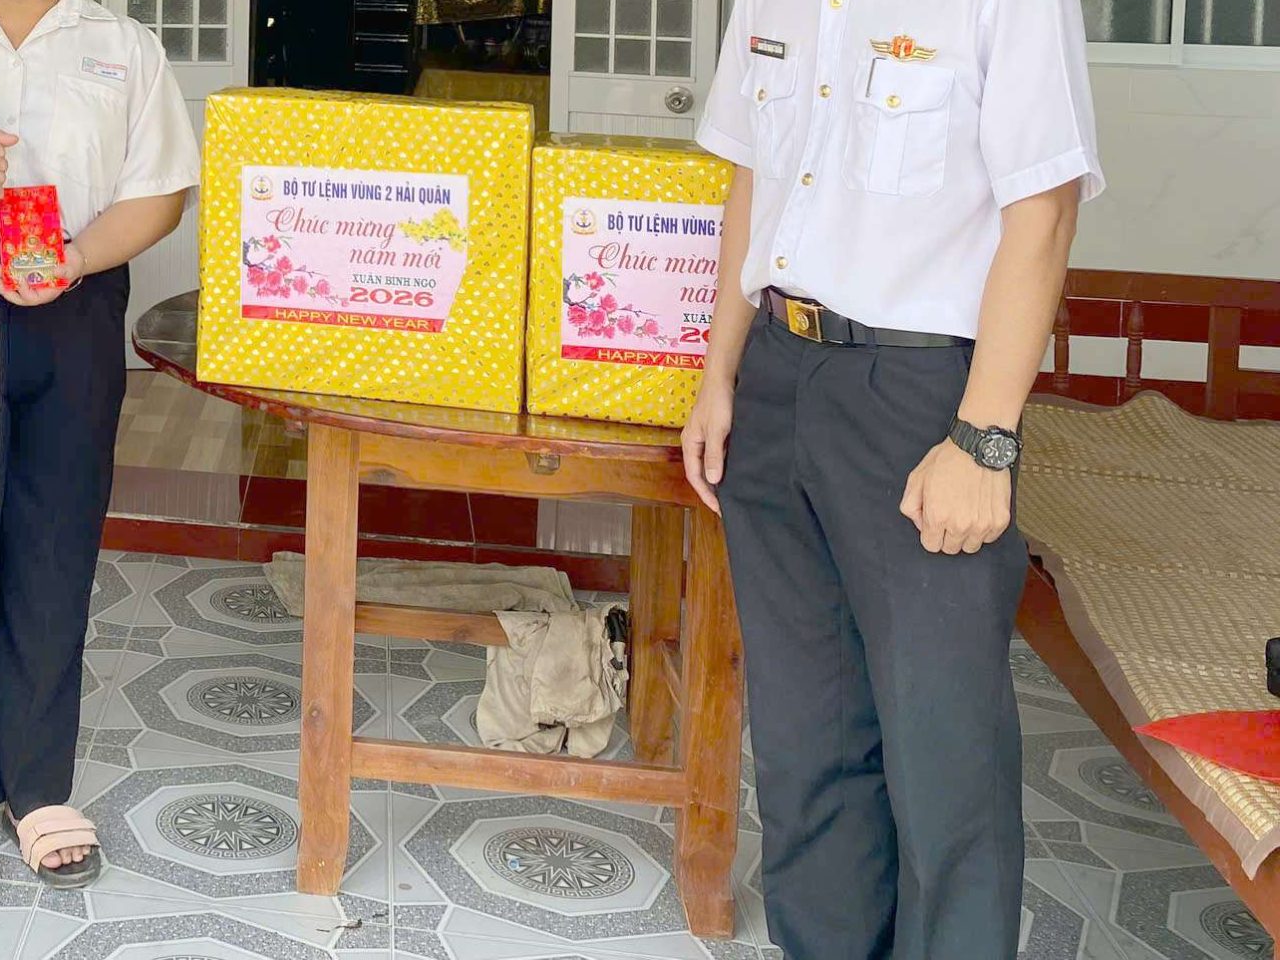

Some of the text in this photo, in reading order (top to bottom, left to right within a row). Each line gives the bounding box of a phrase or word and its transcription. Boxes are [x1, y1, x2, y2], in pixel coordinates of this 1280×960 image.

[283, 177, 451, 205] BỘ TƯ LỆNH VÙNG 2 HẢI QUÂN
[266, 207, 396, 249] Chúc mừng
[607, 211, 624, 235] BỘ
[628, 214, 644, 232] TƯ
[646, 212, 678, 237] LỆNH
[682, 215, 716, 236] VÙNG
[349, 246, 442, 269] năm mới
[588, 242, 719, 276] Chúc mừn
[352, 272, 382, 285] XUÂN
[349, 286, 434, 307] 2026
[275, 309, 430, 330] HAPPY NEW YEAR
[597, 349, 660, 364] HAPPY
